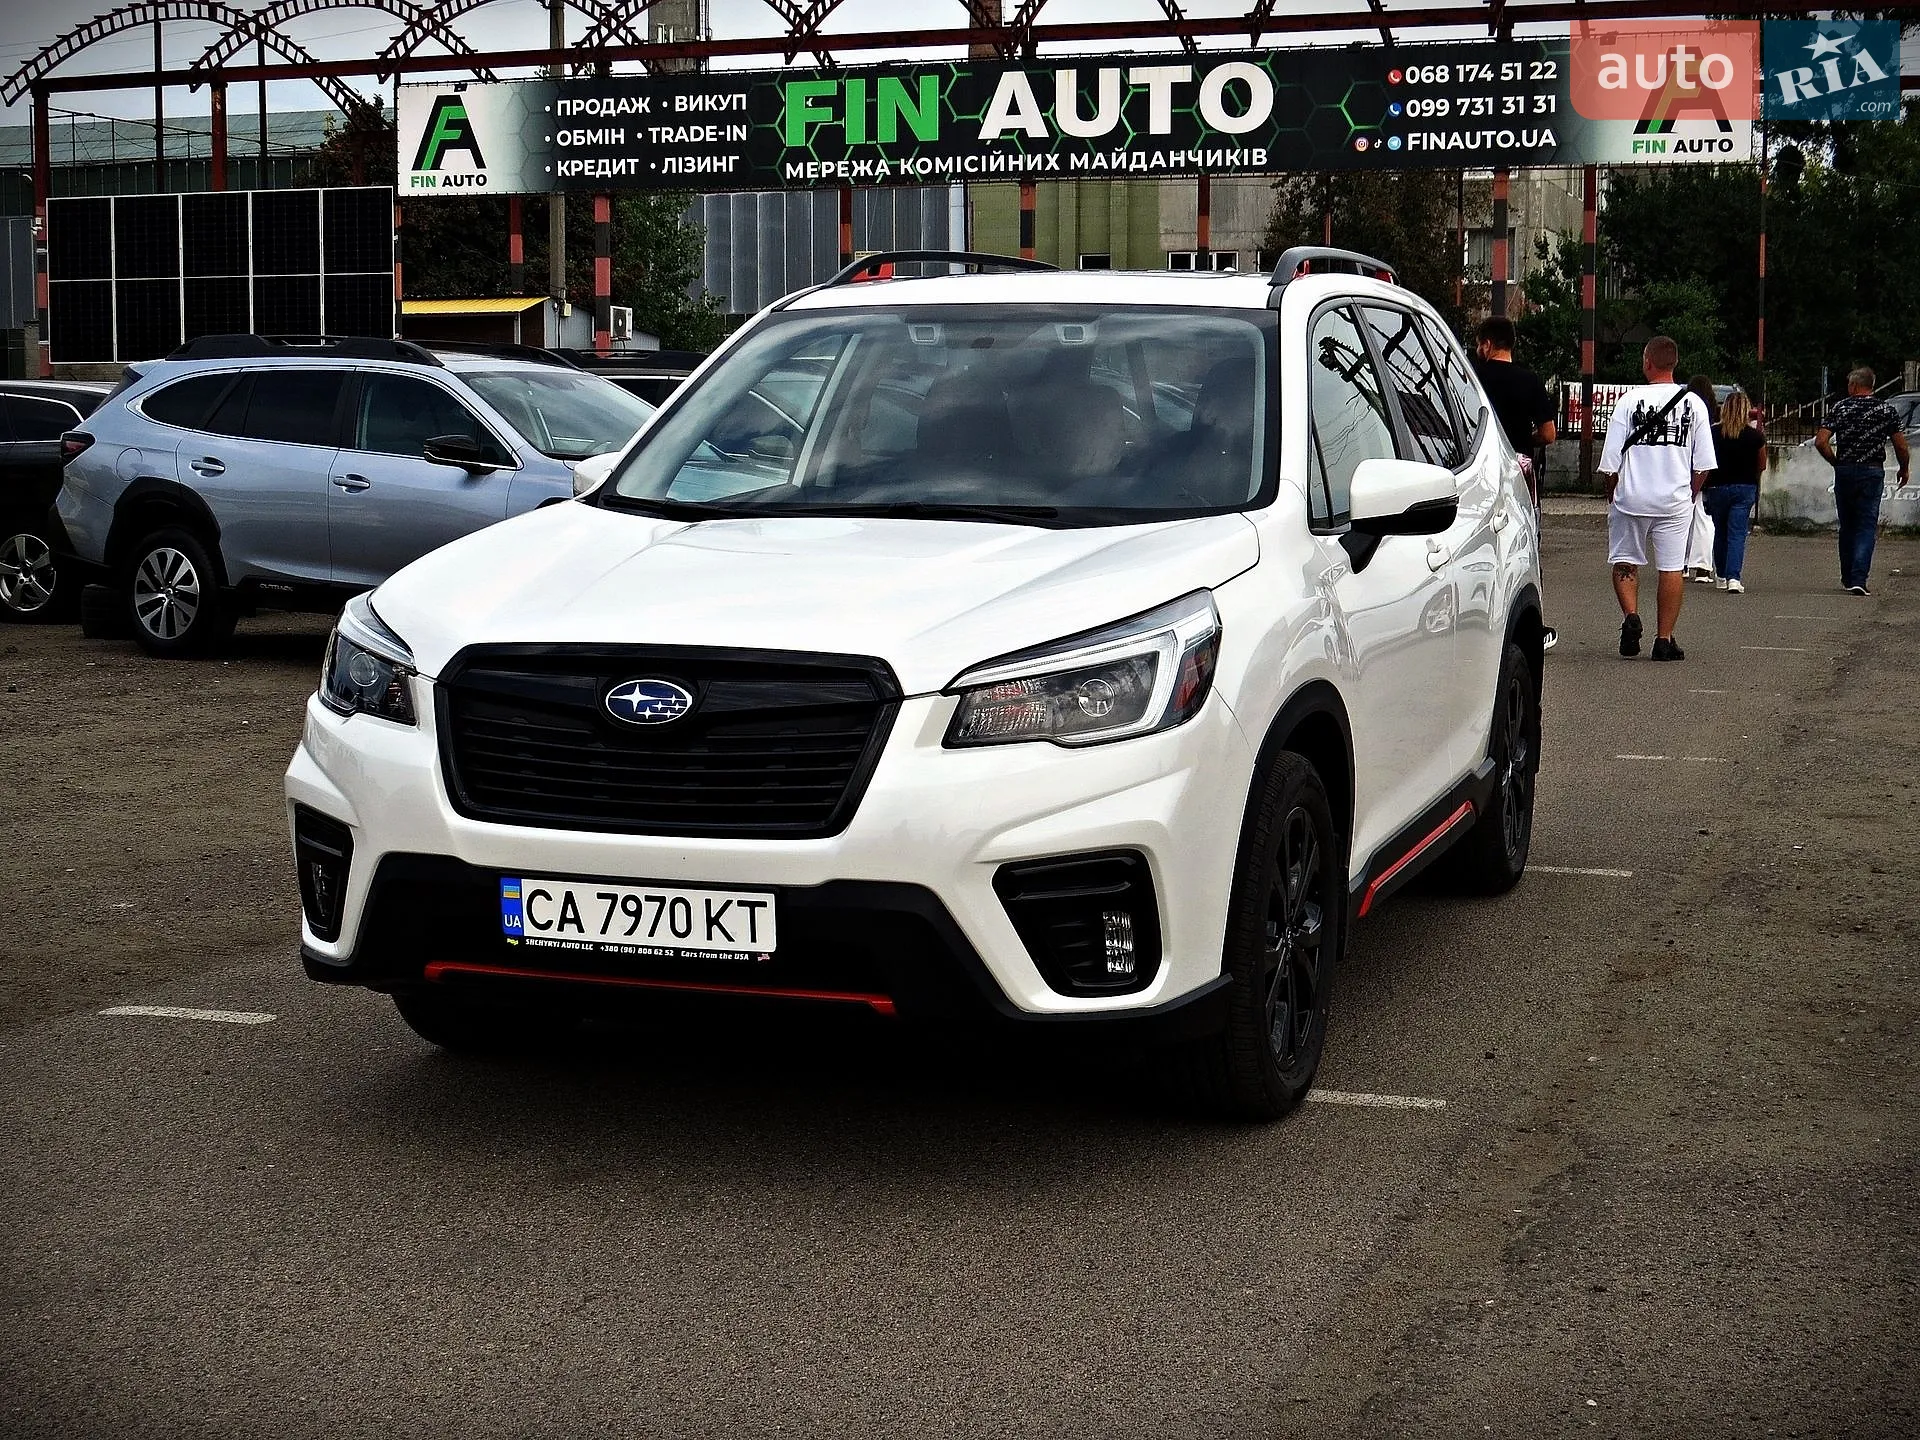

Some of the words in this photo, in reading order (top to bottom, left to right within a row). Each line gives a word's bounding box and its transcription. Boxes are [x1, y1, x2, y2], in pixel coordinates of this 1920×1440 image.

[1406, 65, 1449, 84] 068
[1456, 64, 1494, 82] 174
[1501, 63, 1521, 80] 51
[1530, 61, 1557, 79] 22
[558, 97, 650, 117] ПРОДАЖ
[675, 94, 746, 111] ВИКУП
[784, 75, 939, 147] FIN
[978, 61, 1275, 140] AUTO
[1406, 99, 1449, 117] 099
[1457, 97, 1493, 115] 731
[1502, 96, 1524, 114] 31
[1533, 95, 1555, 113] 31
[557, 128, 624, 146] ОБМІН
[648, 125, 746, 143] TRADE-IN
[1408, 129, 1556, 150] FINAUTO.UA
[1632, 139, 1667, 154] FIN
[1673, 137, 1734, 154] AUTO
[558, 159, 639, 178] КРЕДИТ
[662, 156, 739, 173] ЛІЗИНГ
[786, 160, 891, 179] МЕРЕЖА
[901, 150, 1060, 175] КОМІСІЙНИХ
[1070, 147, 1269, 171] МАЙДАНЧИКІВ
[411, 175, 436, 187] FIN
[442, 173, 487, 187] AUTO
[505, 915, 521, 927] UA
[526, 889, 585, 934] CA
[596, 892, 692, 939] 7970
[704, 898, 768, 944] KT
[620, 946, 636, 954] (96)
[681, 950, 698, 958] Cars
[699, 951, 718, 959] from
